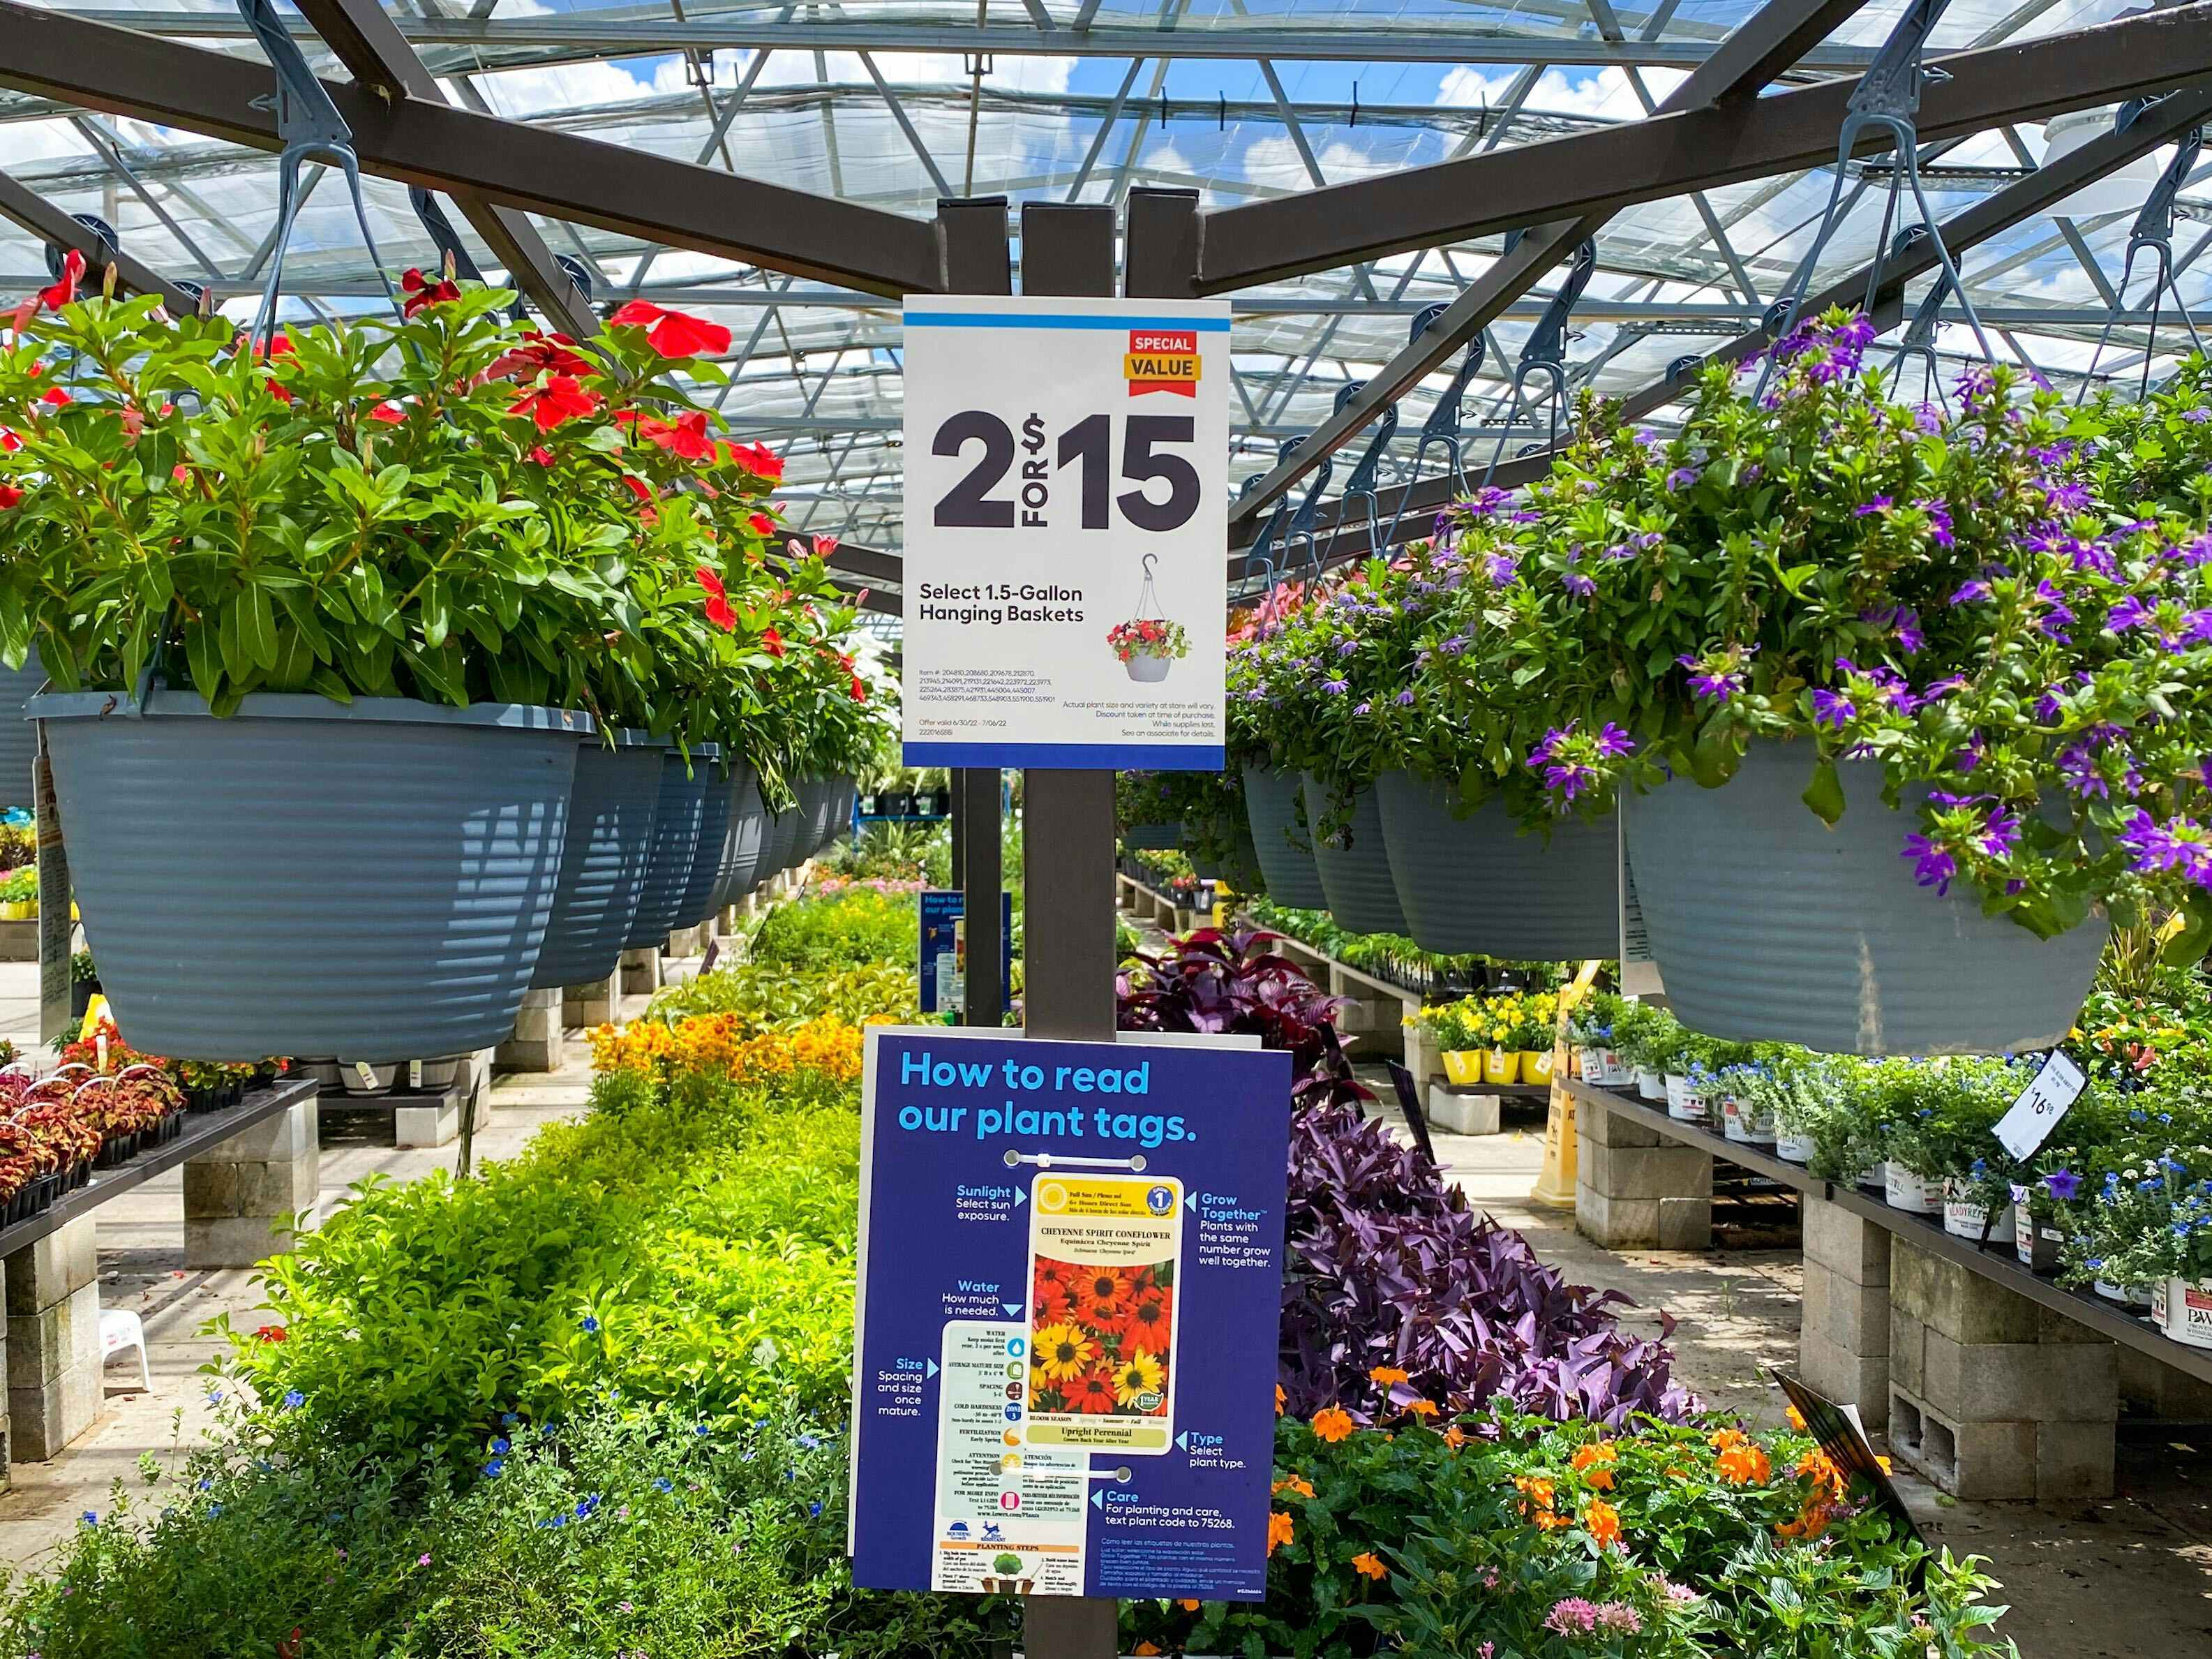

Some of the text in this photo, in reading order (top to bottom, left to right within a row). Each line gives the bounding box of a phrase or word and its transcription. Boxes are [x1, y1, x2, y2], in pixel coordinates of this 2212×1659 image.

[1135, 336, 1191, 350] SPECIAL
[1131, 359, 1193, 375] VALUE
[1021, 413, 1045, 454] $
[932, 410, 1015, 528] 2
[1022, 459, 1048, 527] FOR
[920, 583, 1082, 601] Select 1.5-Gallon
[920, 604, 1083, 625] Hanging Baskets
[1182, 712, 1216, 720] purchase.
[902, 1052, 1149, 1094] How to read
[899, 1101, 1196, 1148] our plant tags.
[957, 1185, 1010, 1200] Sunlight
[956, 1198, 989, 1208] Select
[1155, 1193, 1164, 1207] 1
[1202, 1193, 1237, 1205] Grow
[957, 1212, 1009, 1221] exposure.
[1200, 1220, 1258, 1232] Plants with
[1041, 1228, 1083, 1236] CHEYENNE
[1116, 1230, 1170, 1239] CONEFLOWER
[1200, 1233, 1249, 1243] the same
[1200, 1245, 1270, 1256] number grow
[1199, 1256, 1270, 1268] well together.
[958, 1280, 1000, 1292] Water
[942, 1293, 999, 1304] How much
[945, 1305, 999, 1316] is needed.
[897, 1357, 922, 1369] Size
[879, 1371, 922, 1383] Spacing
[878, 1383, 922, 1392] and size
[879, 1407, 920, 1415] mature.
[1062, 1428, 1091, 1437] Upright
[1191, 1432, 1223, 1445] Type
[1190, 1445, 1223, 1455] Select
[1190, 1457, 1246, 1469] plant type.
[1107, 1490, 1139, 1502] Care
[1106, 1504, 1125, 1513] For
[1126, 1505, 1169, 1517] planting
[1195, 1509, 1221, 1517] care,
[1105, 1516, 1126, 1524] text
[1129, 1517, 1156, 1526] plant
[1159, 1518, 1186, 1526] code
[1202, 1519, 1235, 1528] 75268.
